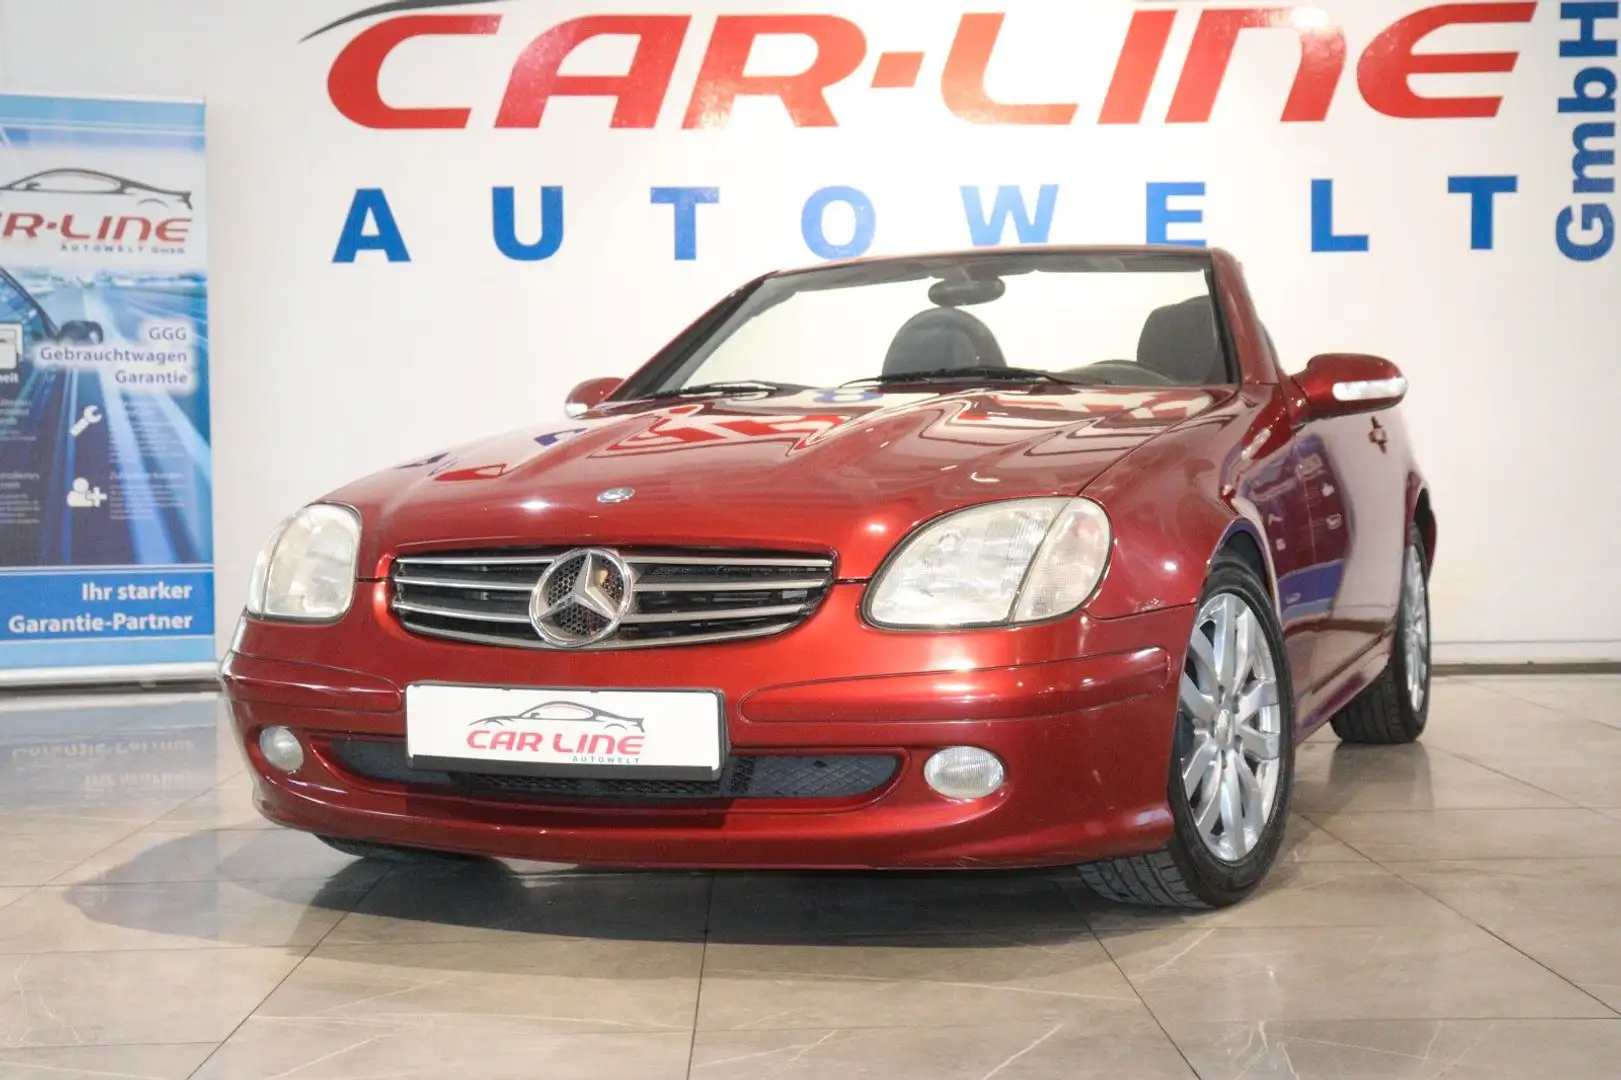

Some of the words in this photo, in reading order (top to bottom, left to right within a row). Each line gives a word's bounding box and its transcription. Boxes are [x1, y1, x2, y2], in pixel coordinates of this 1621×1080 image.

[1556, 2, 1619, 262] GmbH
[0, 212, 192, 243] R-LINE
[332, 175, 1518, 263] AUTOWELT
[61, 244, 143, 253] AUTOWELT
[149, 326, 187, 341] GGG
[40, 346, 187, 365] Gebrauchtwagen
[115, 369, 188, 385] Garantie
[82, 582, 112, 601] Ihr
[117, 581, 192, 600] starker
[8, 612, 193, 633] Garantie-Partner
[466, 729, 544, 751] CAR
[552, 733, 645, 755] LINE
[572, 755, 641, 763] AUTOWELT
